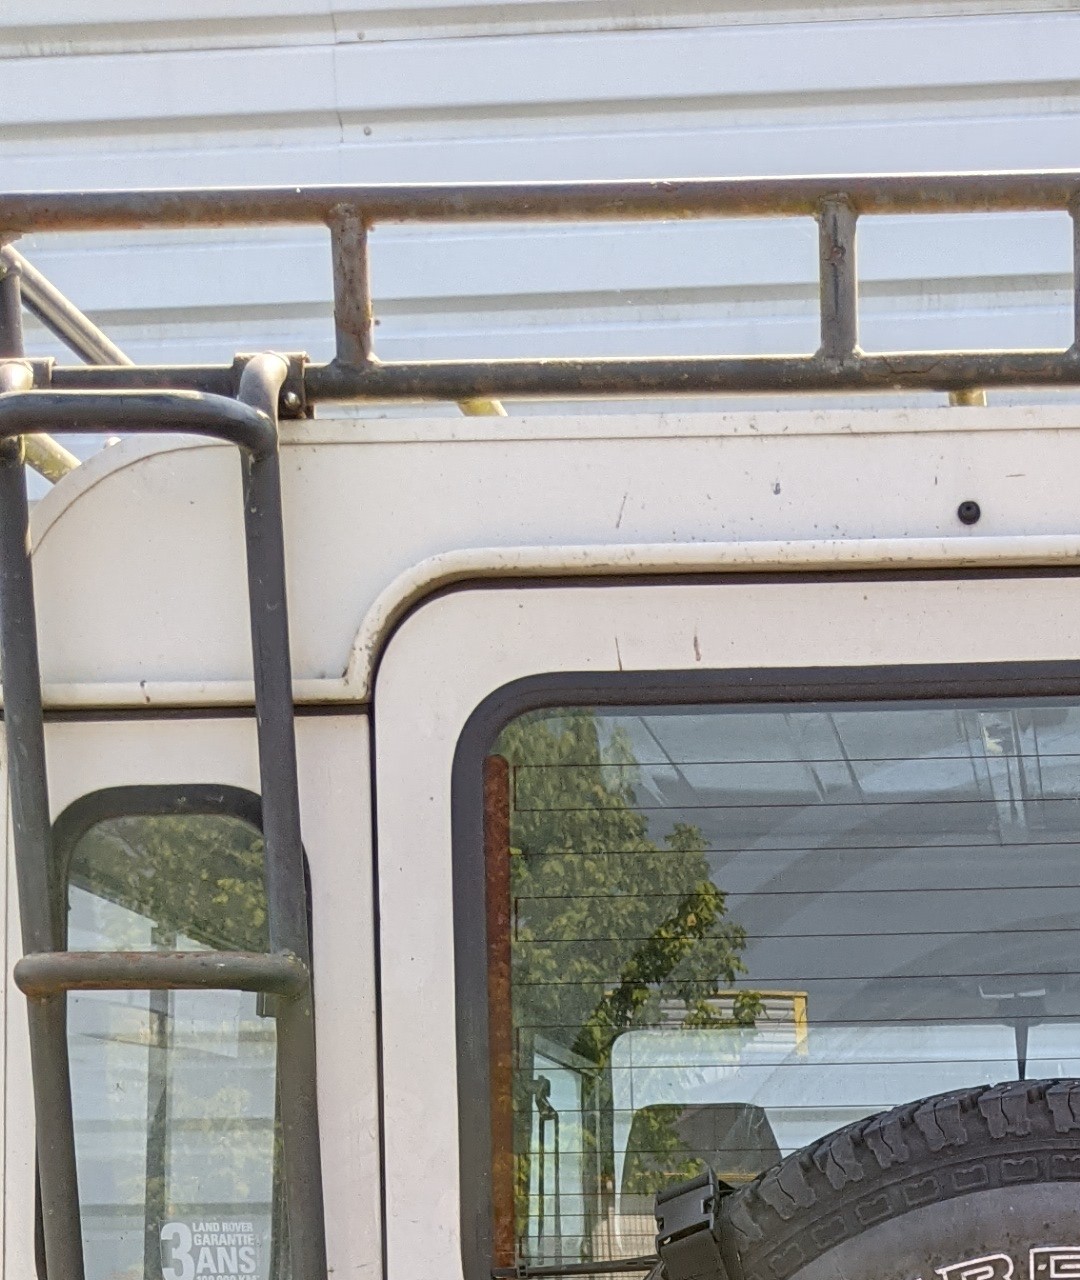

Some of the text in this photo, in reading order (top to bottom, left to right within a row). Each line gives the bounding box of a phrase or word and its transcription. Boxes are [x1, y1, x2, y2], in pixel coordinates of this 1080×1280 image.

[192, 1221, 253, 1232] LAND ROVER
[193, 1233, 254, 1246] GARANTIE
[196, 1246, 256, 1274] ANS
